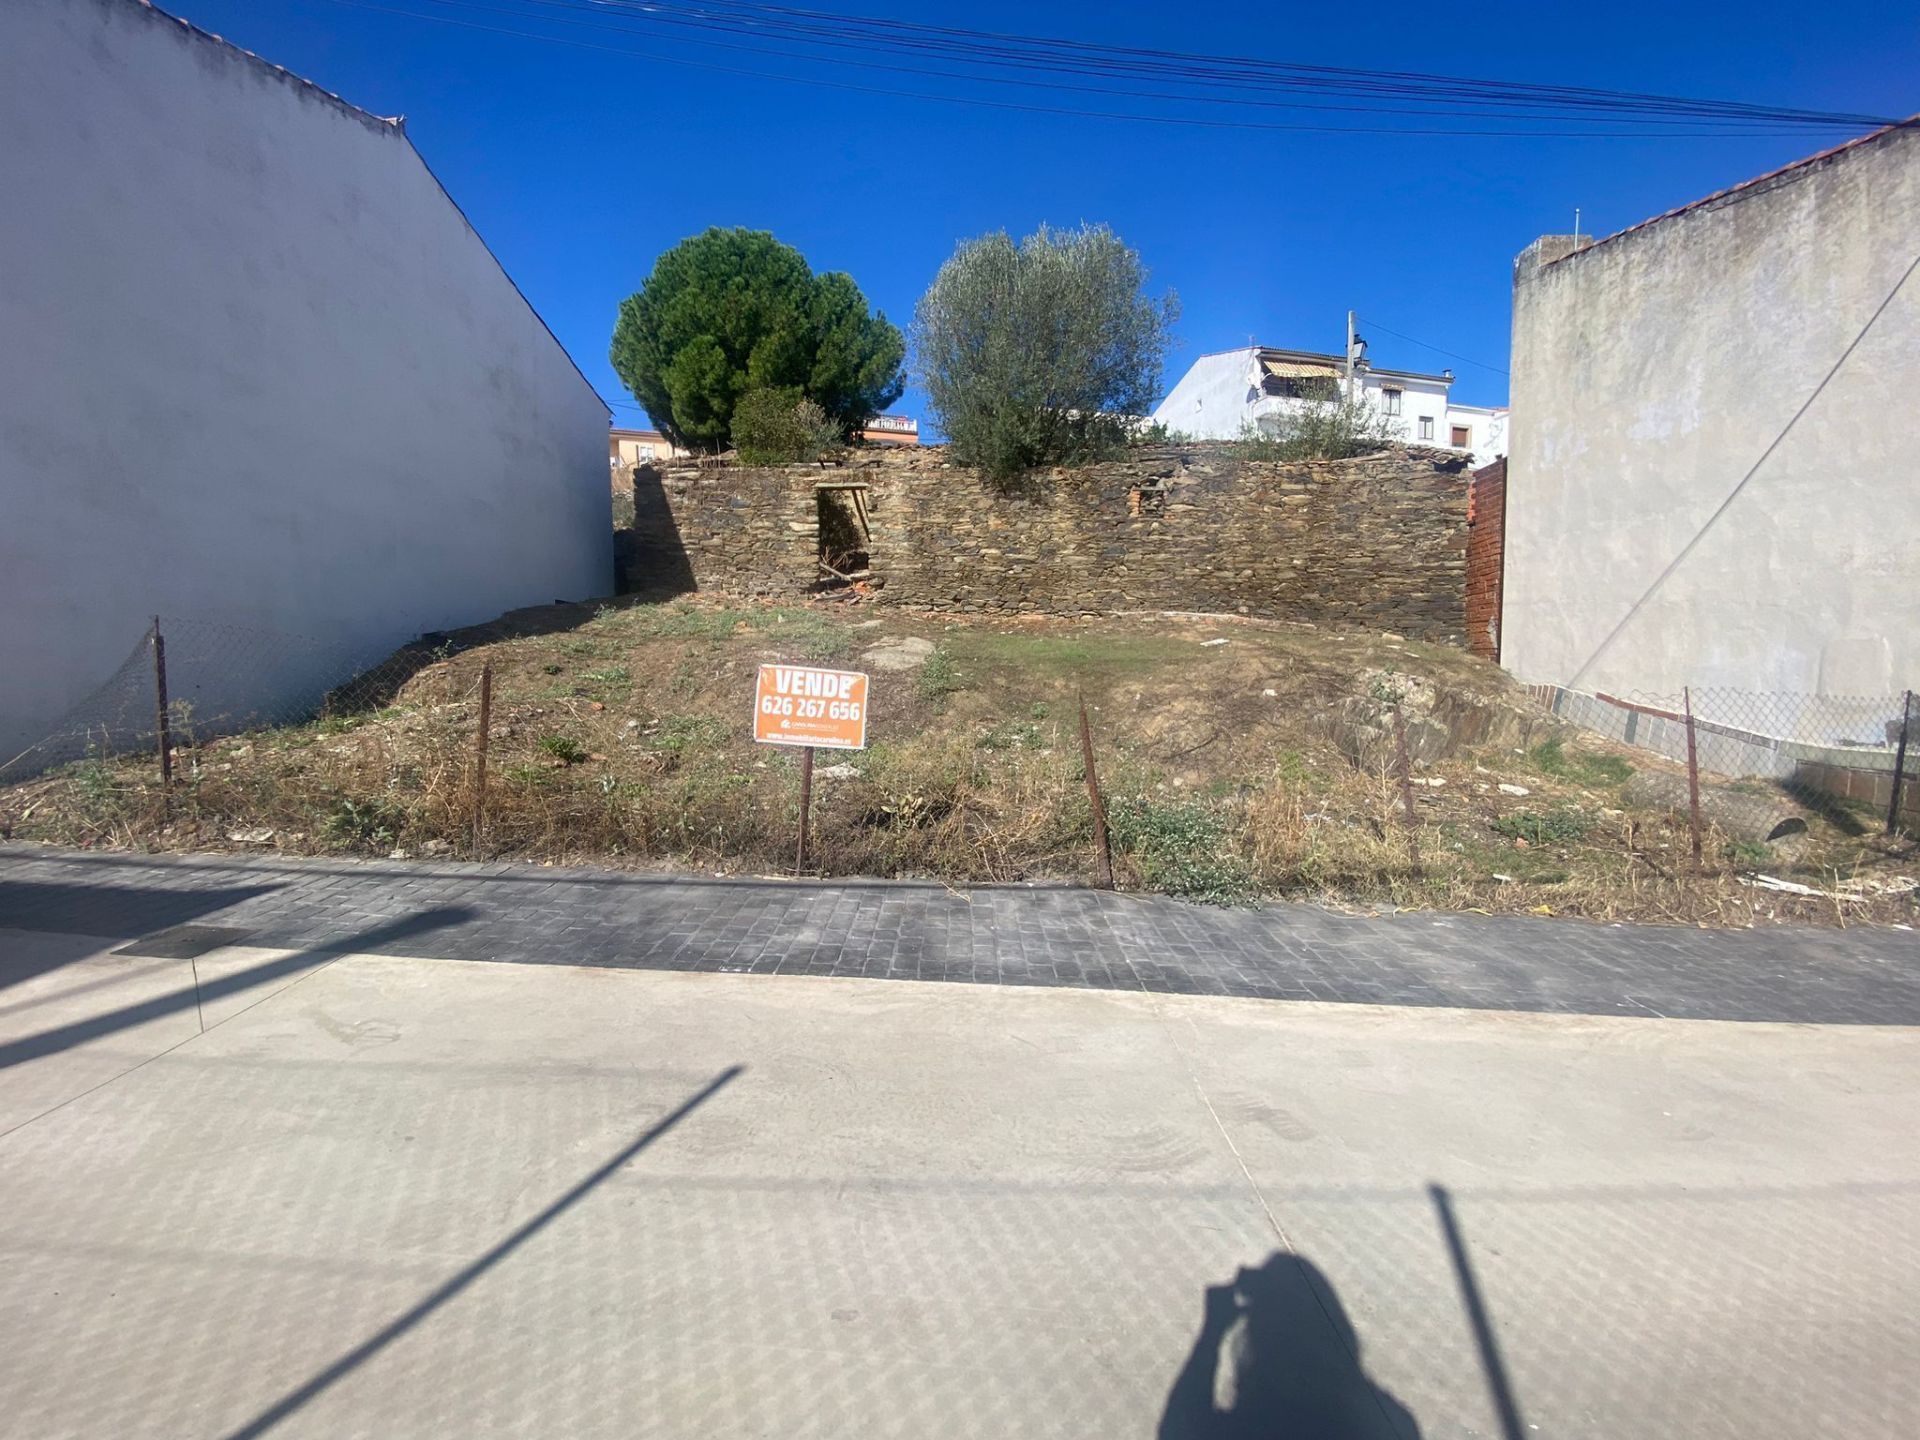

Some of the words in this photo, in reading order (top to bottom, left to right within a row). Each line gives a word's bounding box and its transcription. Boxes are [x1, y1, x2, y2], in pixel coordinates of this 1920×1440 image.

[776, 669, 851, 699] VENDE
[762, 695, 793, 716] 626
[796, 698, 826, 718] 267
[829, 701, 860, 721] 656
